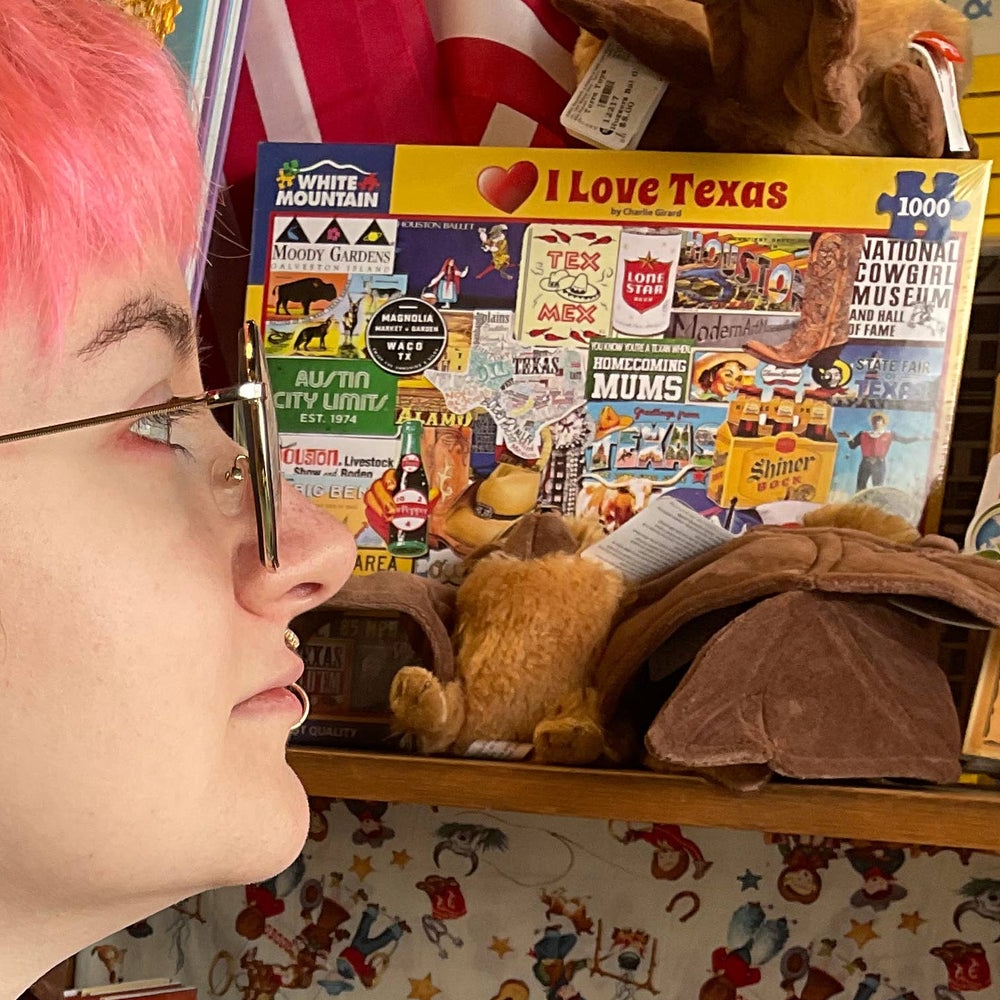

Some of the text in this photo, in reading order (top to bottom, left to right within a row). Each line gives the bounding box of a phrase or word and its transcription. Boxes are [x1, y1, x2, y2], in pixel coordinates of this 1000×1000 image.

[298, 174, 358, 190] WHITE
[546, 169, 788, 210] I Love Texas
[275, 190, 379, 208] MOUNTAIN
[897, 197, 950, 217] 1000
[610, 207, 682, 218] by Charlie Girard
[443, 222, 475, 231] BALLET
[272, 244, 391, 264] MOODY GARDENS
[860, 239, 960, 263] NATIONAL
[547, 251, 600, 271] TEX
[627, 272, 664, 283] LONE
[856, 263, 954, 286] COWGIRL
[625, 284, 664, 295] STAR
[852, 286, 949, 309] MUSEUM
[381, 314, 434, 323] MAGNOLIA
[537, 303, 597, 324] MEX
[850, 309, 904, 323] AND HALL
[864, 324, 896, 337] FAME
[387, 342, 423, 351] WACO
[397, 353, 412, 361] TX
[593, 357, 687, 372] HOMECOMING
[512, 357, 559, 375] TEXAS
[856, 358, 930, 373] STATE FAIR
[295, 370, 370, 389] AUSTIN
[591, 373, 682, 401] MUMS
[273, 392, 389, 411] CITY LIMITS
[300, 414, 357, 424] EST. 1974
[344, 456, 394, 468] Livestock
[748, 456, 816, 482] Shiner
[294, 467, 321, 476] Show
[340, 469, 373, 478] Rodeo
[757, 476, 802, 492] BOCK
[354, 556, 397, 572] AREA
